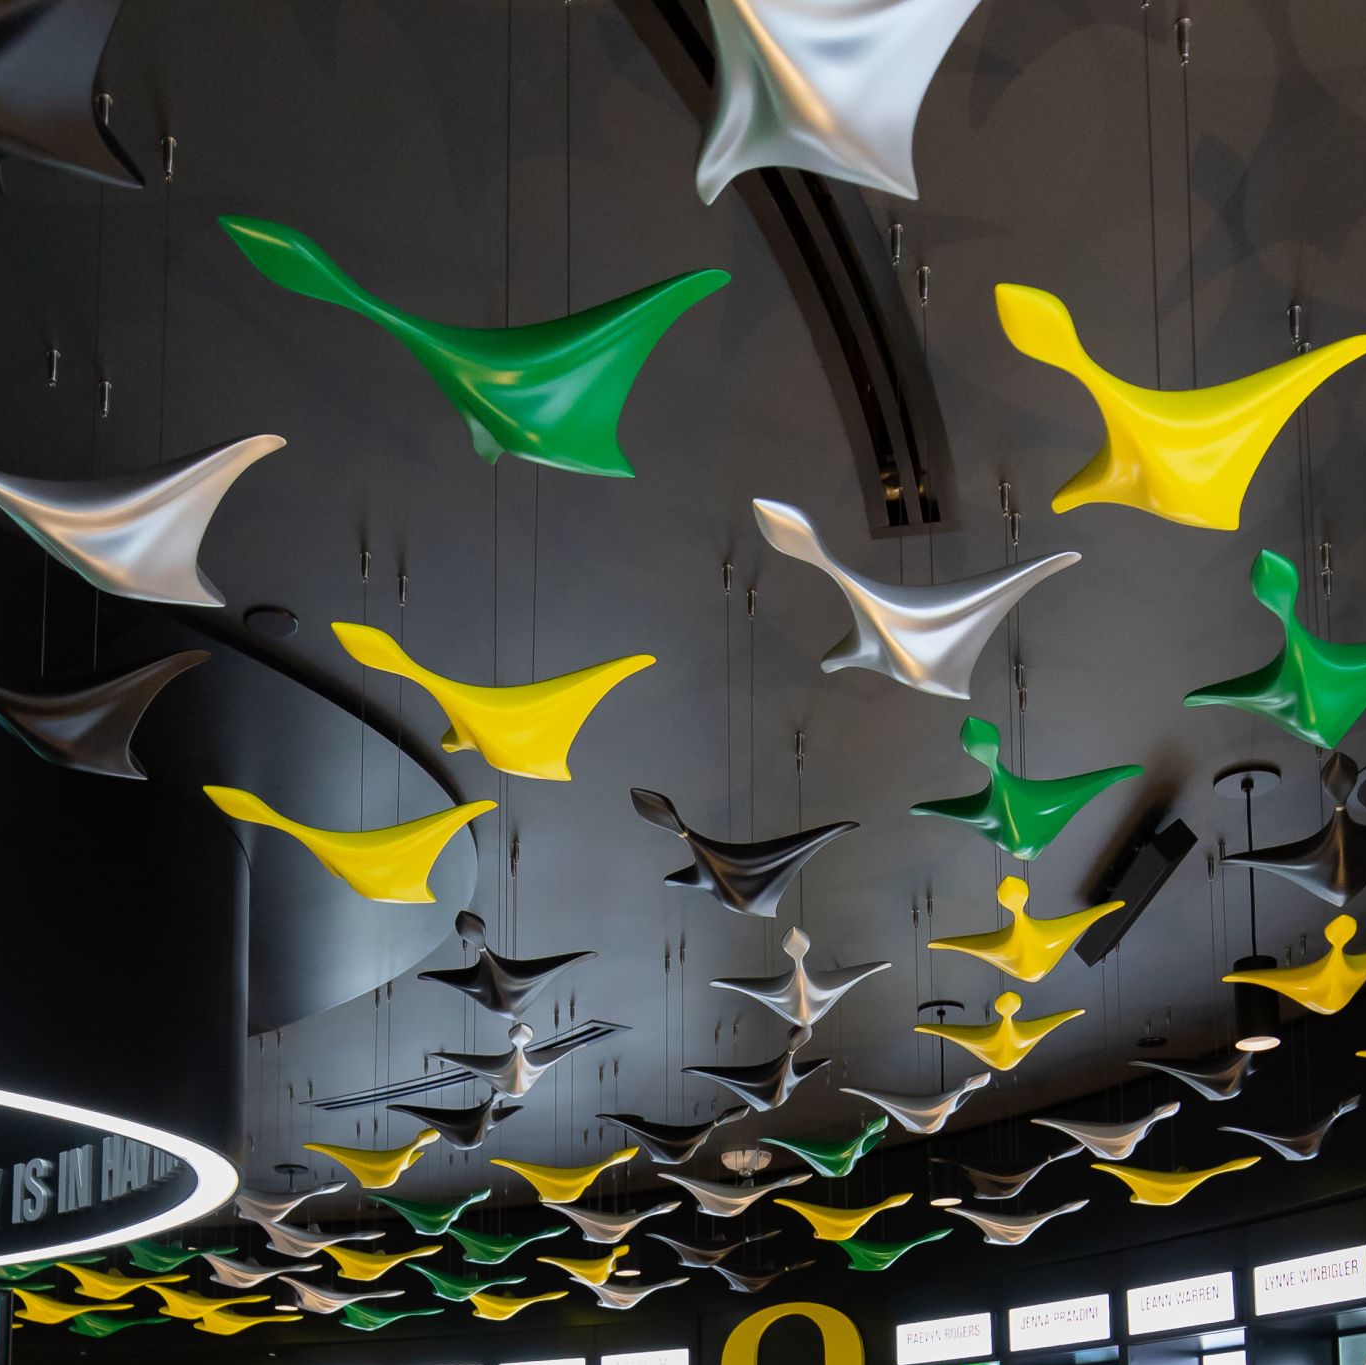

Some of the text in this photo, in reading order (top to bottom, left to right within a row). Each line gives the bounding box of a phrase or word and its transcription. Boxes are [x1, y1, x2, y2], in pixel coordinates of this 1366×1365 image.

[11, 1157, 52, 1224] IS
[57, 1144, 95, 1213] IN
[1264, 1259, 1359, 1291] LYNNE WINBIGLER
[1140, 1285, 1220, 1312] LEANN WARREN
[1020, 1313, 1050, 1330] JENNA
